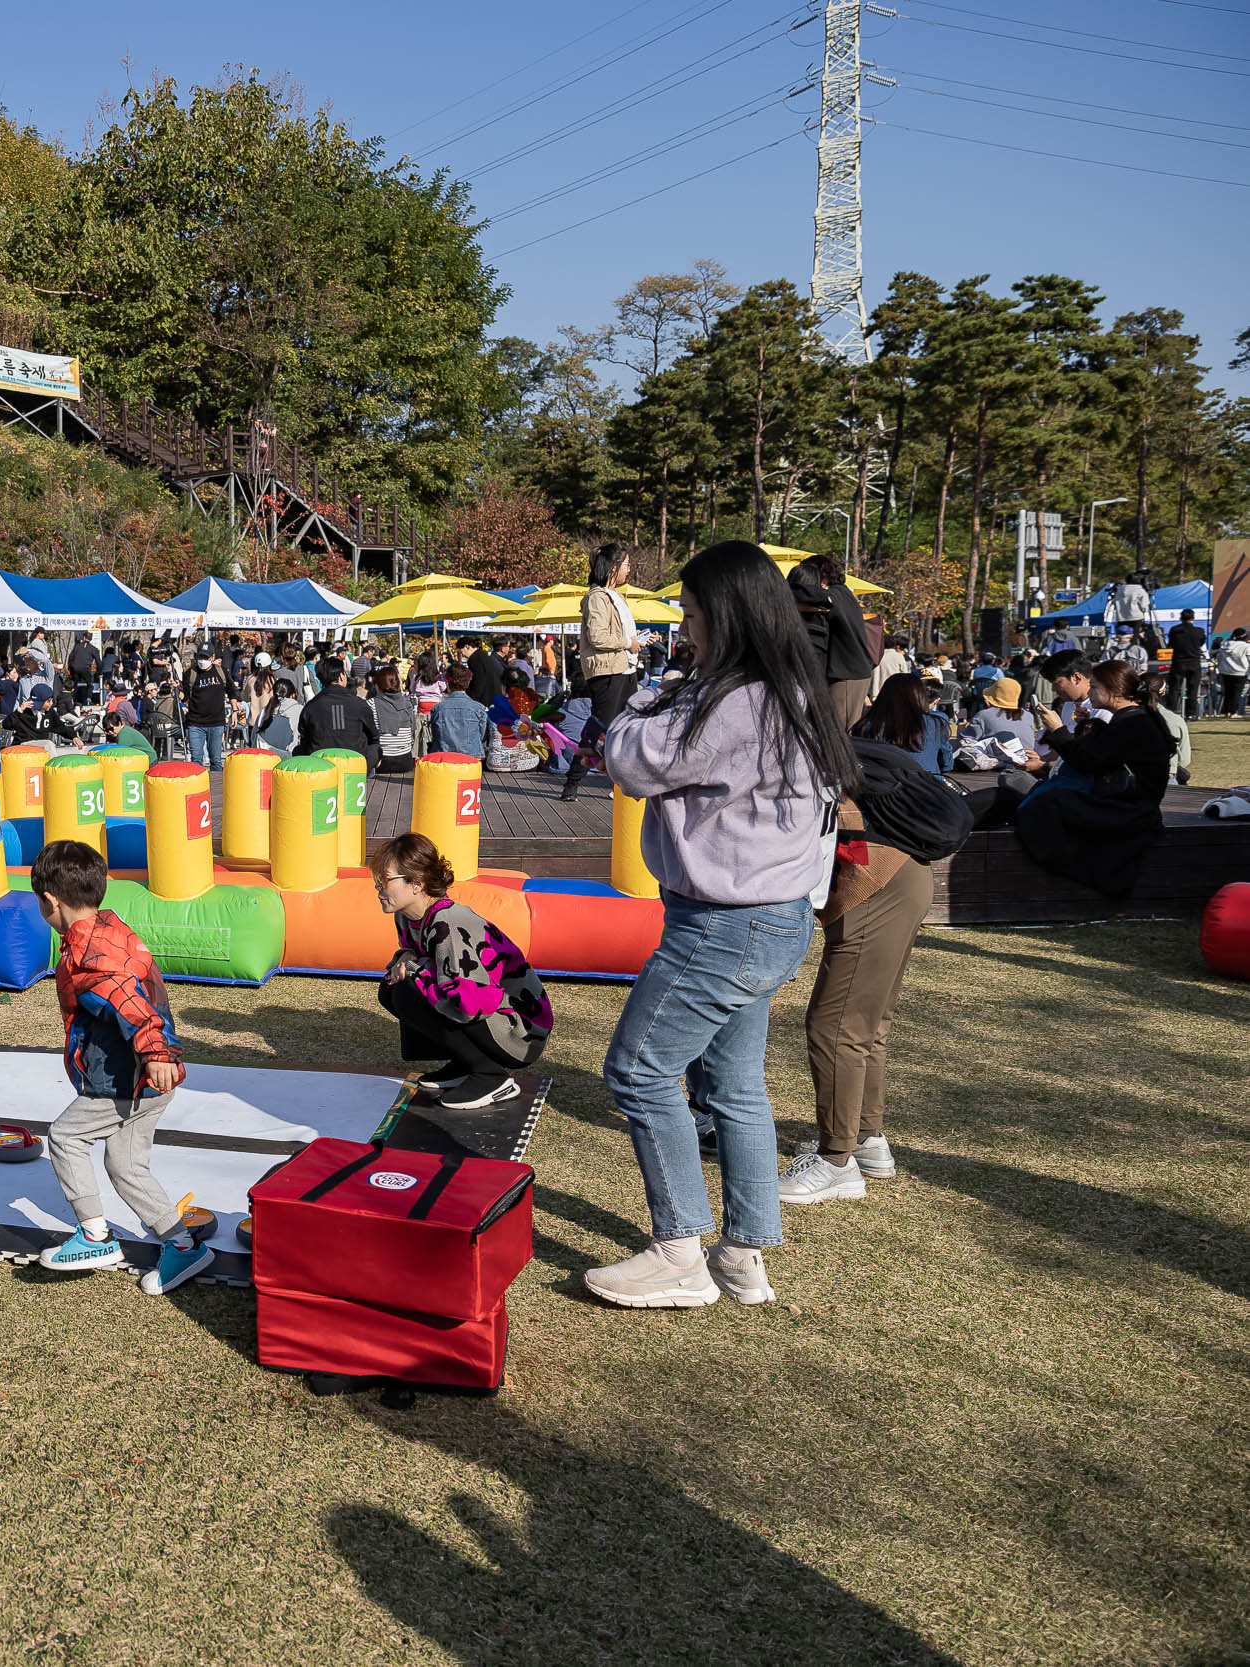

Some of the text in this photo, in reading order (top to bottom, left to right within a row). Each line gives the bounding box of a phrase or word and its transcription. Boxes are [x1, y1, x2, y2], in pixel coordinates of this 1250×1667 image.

[18, 361, 46, 380] 축제
[0, 616, 24, 627] 광장동
[25, 616, 49, 628] 상인회
[115, 616, 138, 627] 광장동
[141, 616, 162, 627] 상인회
[238, 616, 258, 626] 광장동
[260, 616, 279, 626] 체육회
[126, 779, 144, 804] 3
[81, 788, 105, 816] 30
[381, 1179, 407, 1187] CURL
[57, 1245, 115, 1263] SUPERSTAR
